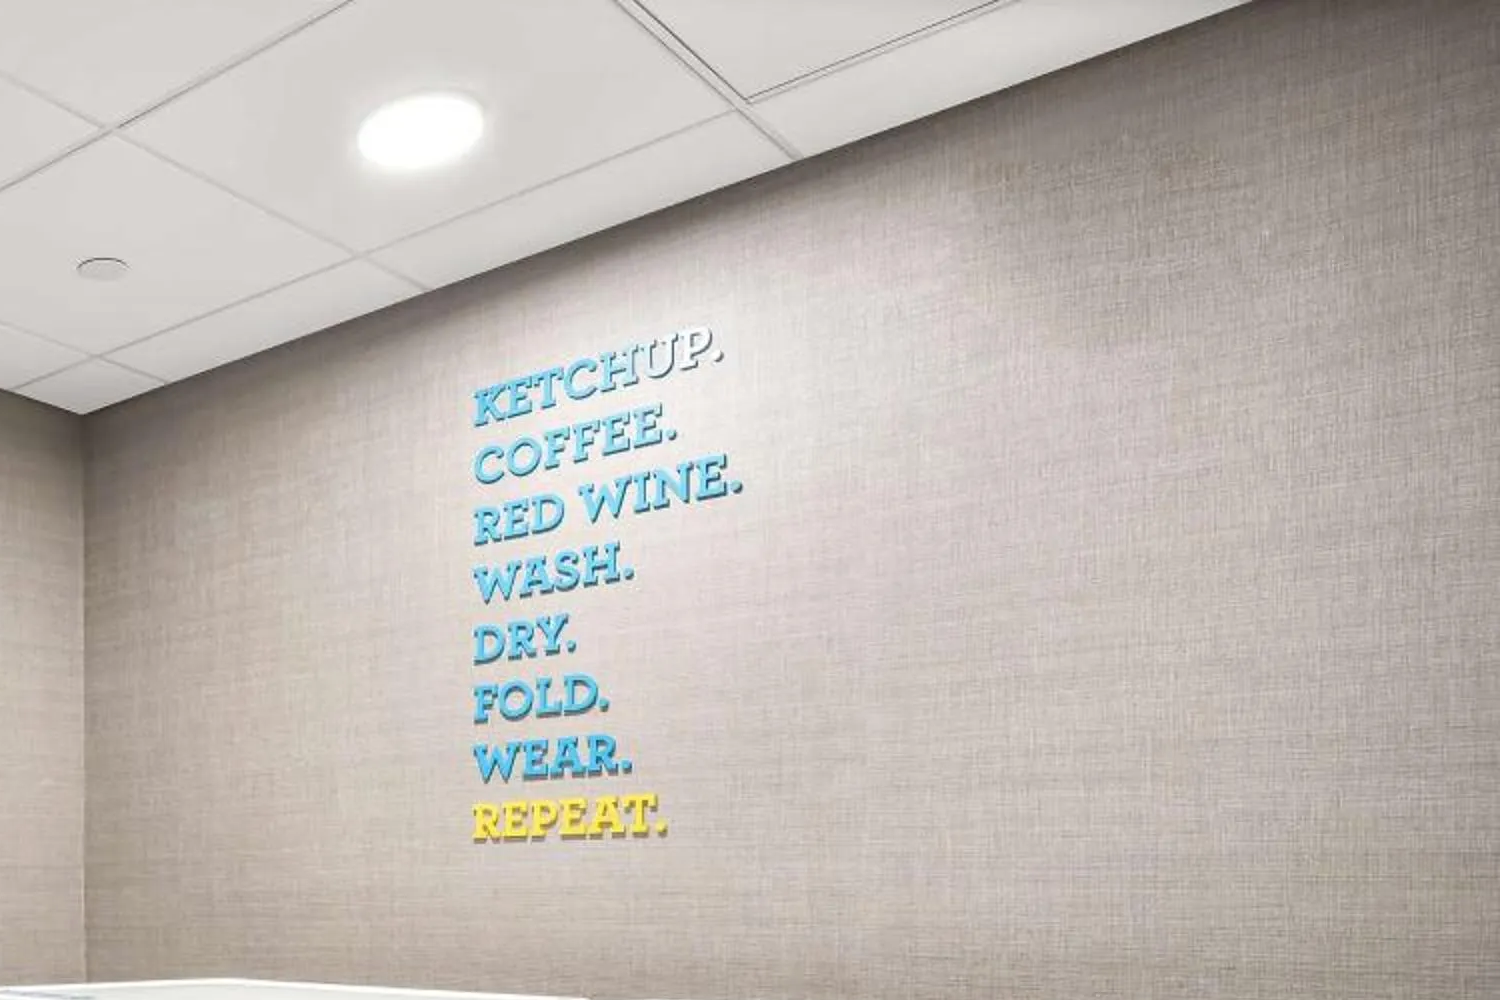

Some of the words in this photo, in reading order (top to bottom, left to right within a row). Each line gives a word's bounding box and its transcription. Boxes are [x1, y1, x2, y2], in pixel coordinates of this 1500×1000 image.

[473, 325, 725, 427] KETCHUP.
[473, 402, 678, 485] COFFEE.
[473, 492, 565, 545] RED
[578, 453, 744, 525] WINE.
[471, 541, 636, 604] WASH.
[473, 612, 577, 666] DRY.
[473, 672, 610, 724] FOLD.
[471, 734, 634, 785] WEAR.
[472, 792, 669, 843] REPEAT.
